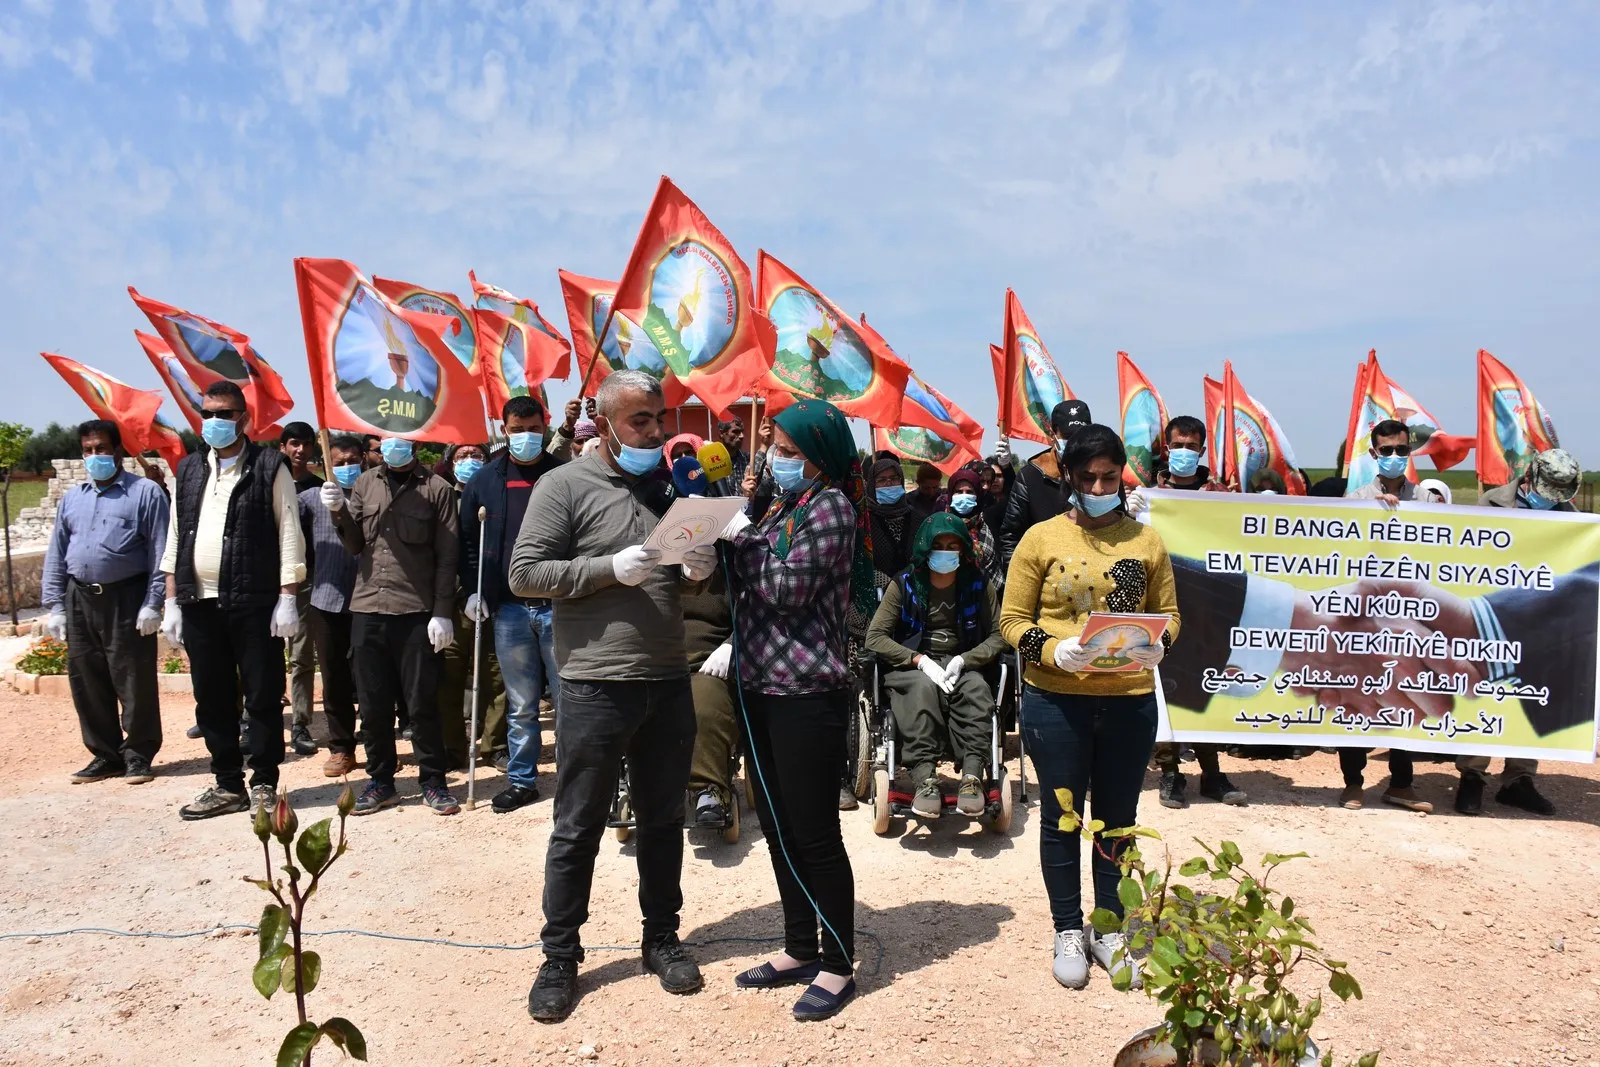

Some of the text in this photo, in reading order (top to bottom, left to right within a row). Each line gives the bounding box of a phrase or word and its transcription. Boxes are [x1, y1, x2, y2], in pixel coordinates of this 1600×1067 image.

[1243, 517, 1512, 549] BI BANGA RÊBER APO
[1208, 552, 1553, 589] EM TEVAHÎ HÊZÊN SIYASÎYÊ
[1310, 591, 1438, 619] YÊN KÛRD
[1231, 626, 1520, 661] DEWETÎ YEKÎTÎYÊ DIKIN
[1203, 669, 1266, 691] جميع
[1399, 673, 1467, 693] القائد
[1475, 681, 1549, 703] بصوت
[1236, 706, 1503, 738] الأحزاب الكردية للتوحيد
